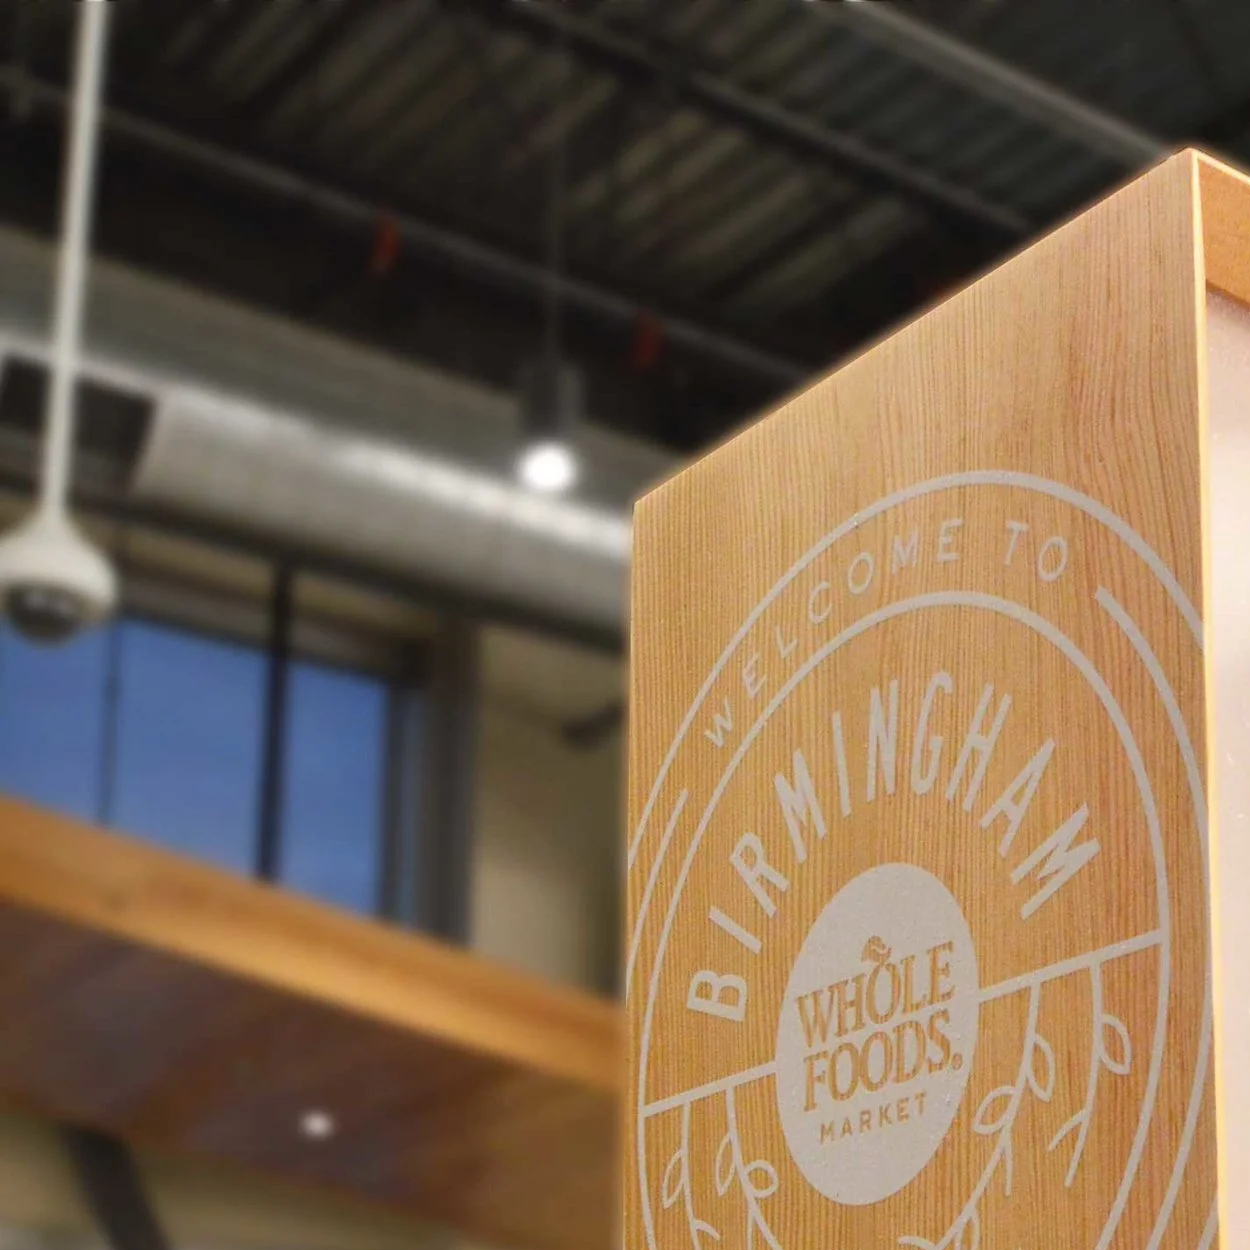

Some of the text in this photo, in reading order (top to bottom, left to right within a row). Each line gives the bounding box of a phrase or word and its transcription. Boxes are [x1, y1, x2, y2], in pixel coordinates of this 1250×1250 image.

[704, 518, 1069, 749] WELCOME TO
[686, 671, 1100, 1023] BIRMINGHAM
[796, 941, 956, 1048] WHOLE
[819, 1091, 928, 1145] MARKET
